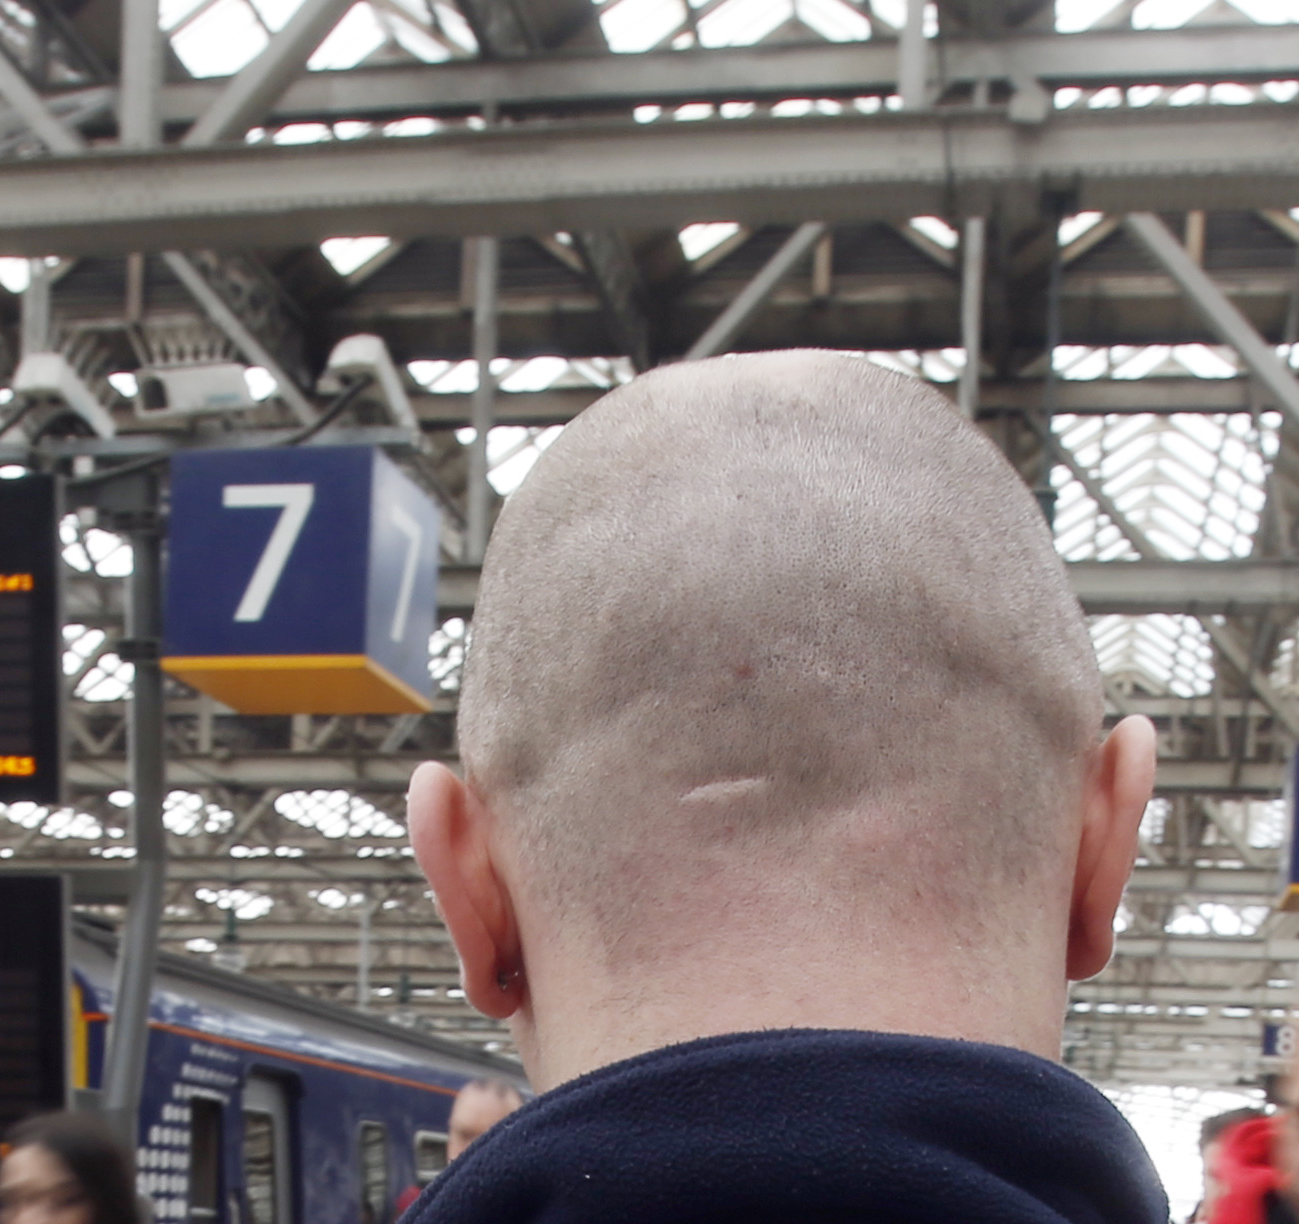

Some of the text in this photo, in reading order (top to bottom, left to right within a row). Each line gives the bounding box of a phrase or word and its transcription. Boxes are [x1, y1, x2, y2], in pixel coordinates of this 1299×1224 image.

[222, 482, 315, 623] 7
[388, 503, 422, 643] 7
[1275, 1025, 1297, 1056] 8
